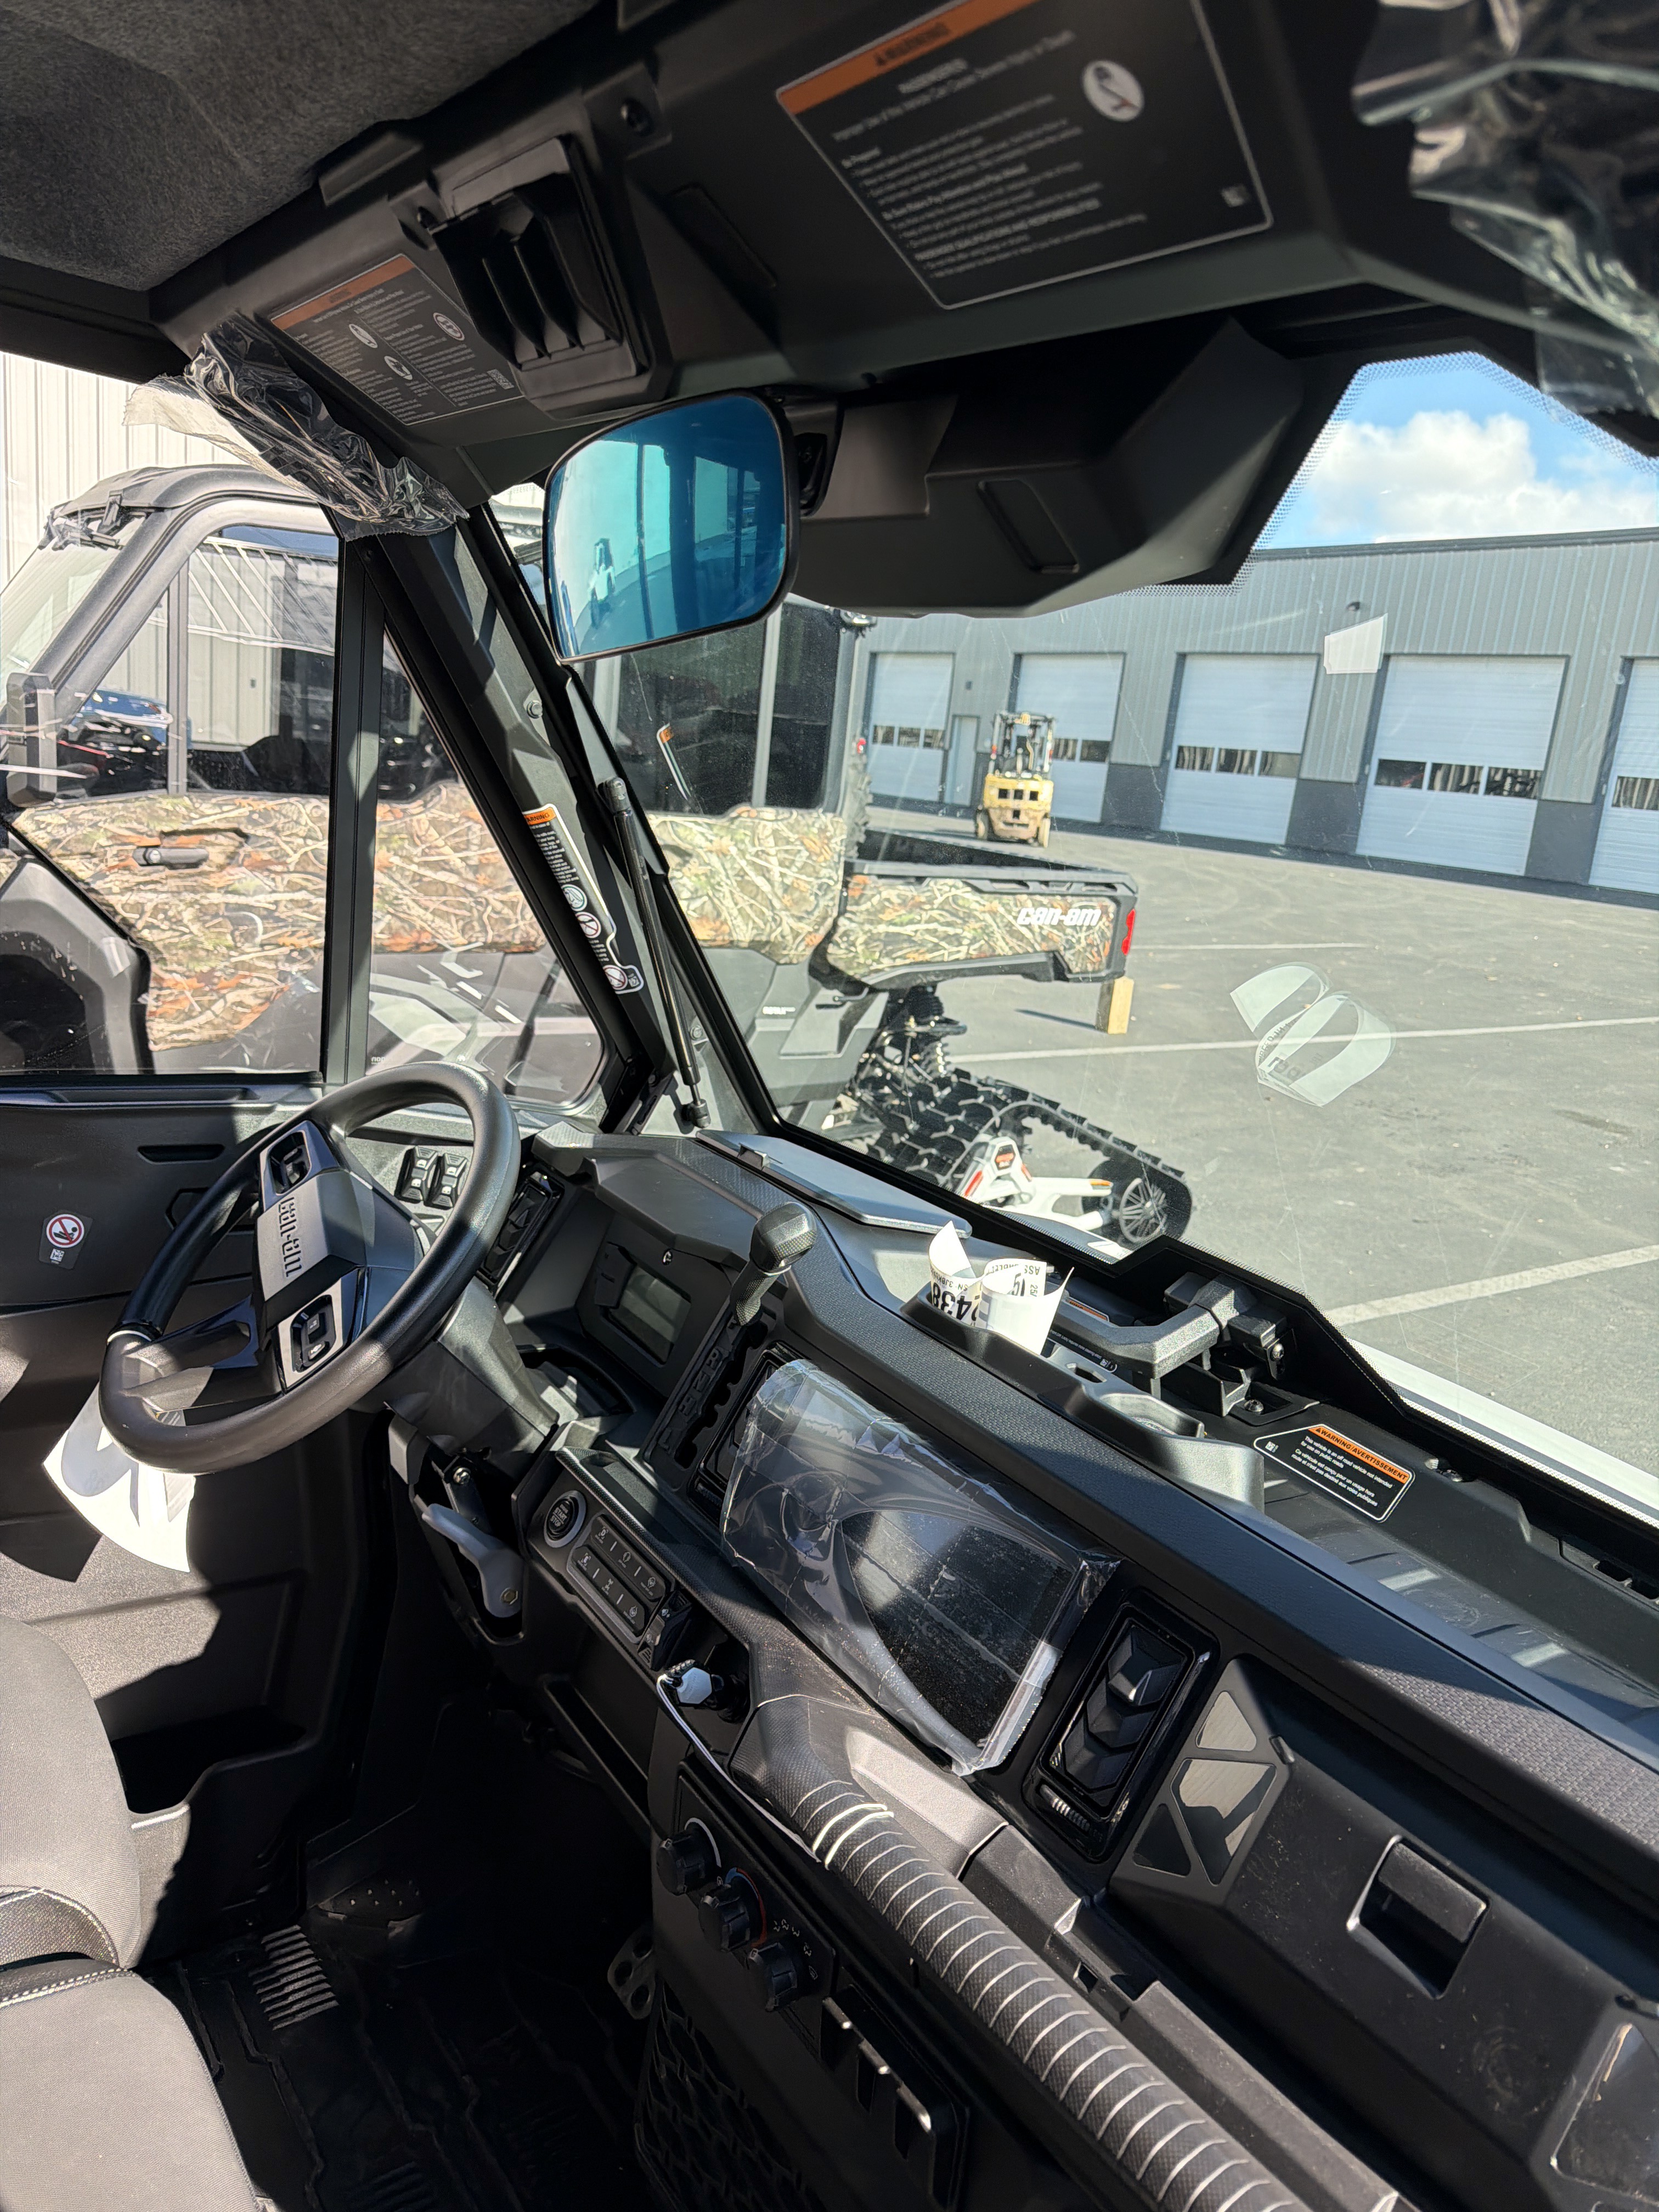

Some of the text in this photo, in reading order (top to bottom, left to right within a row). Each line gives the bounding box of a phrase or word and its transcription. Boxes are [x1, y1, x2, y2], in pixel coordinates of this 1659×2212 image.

[525, 812, 550, 823] ARNING
[554, 1507, 568, 1521] START
[550, 1515, 561, 1527] STOP
